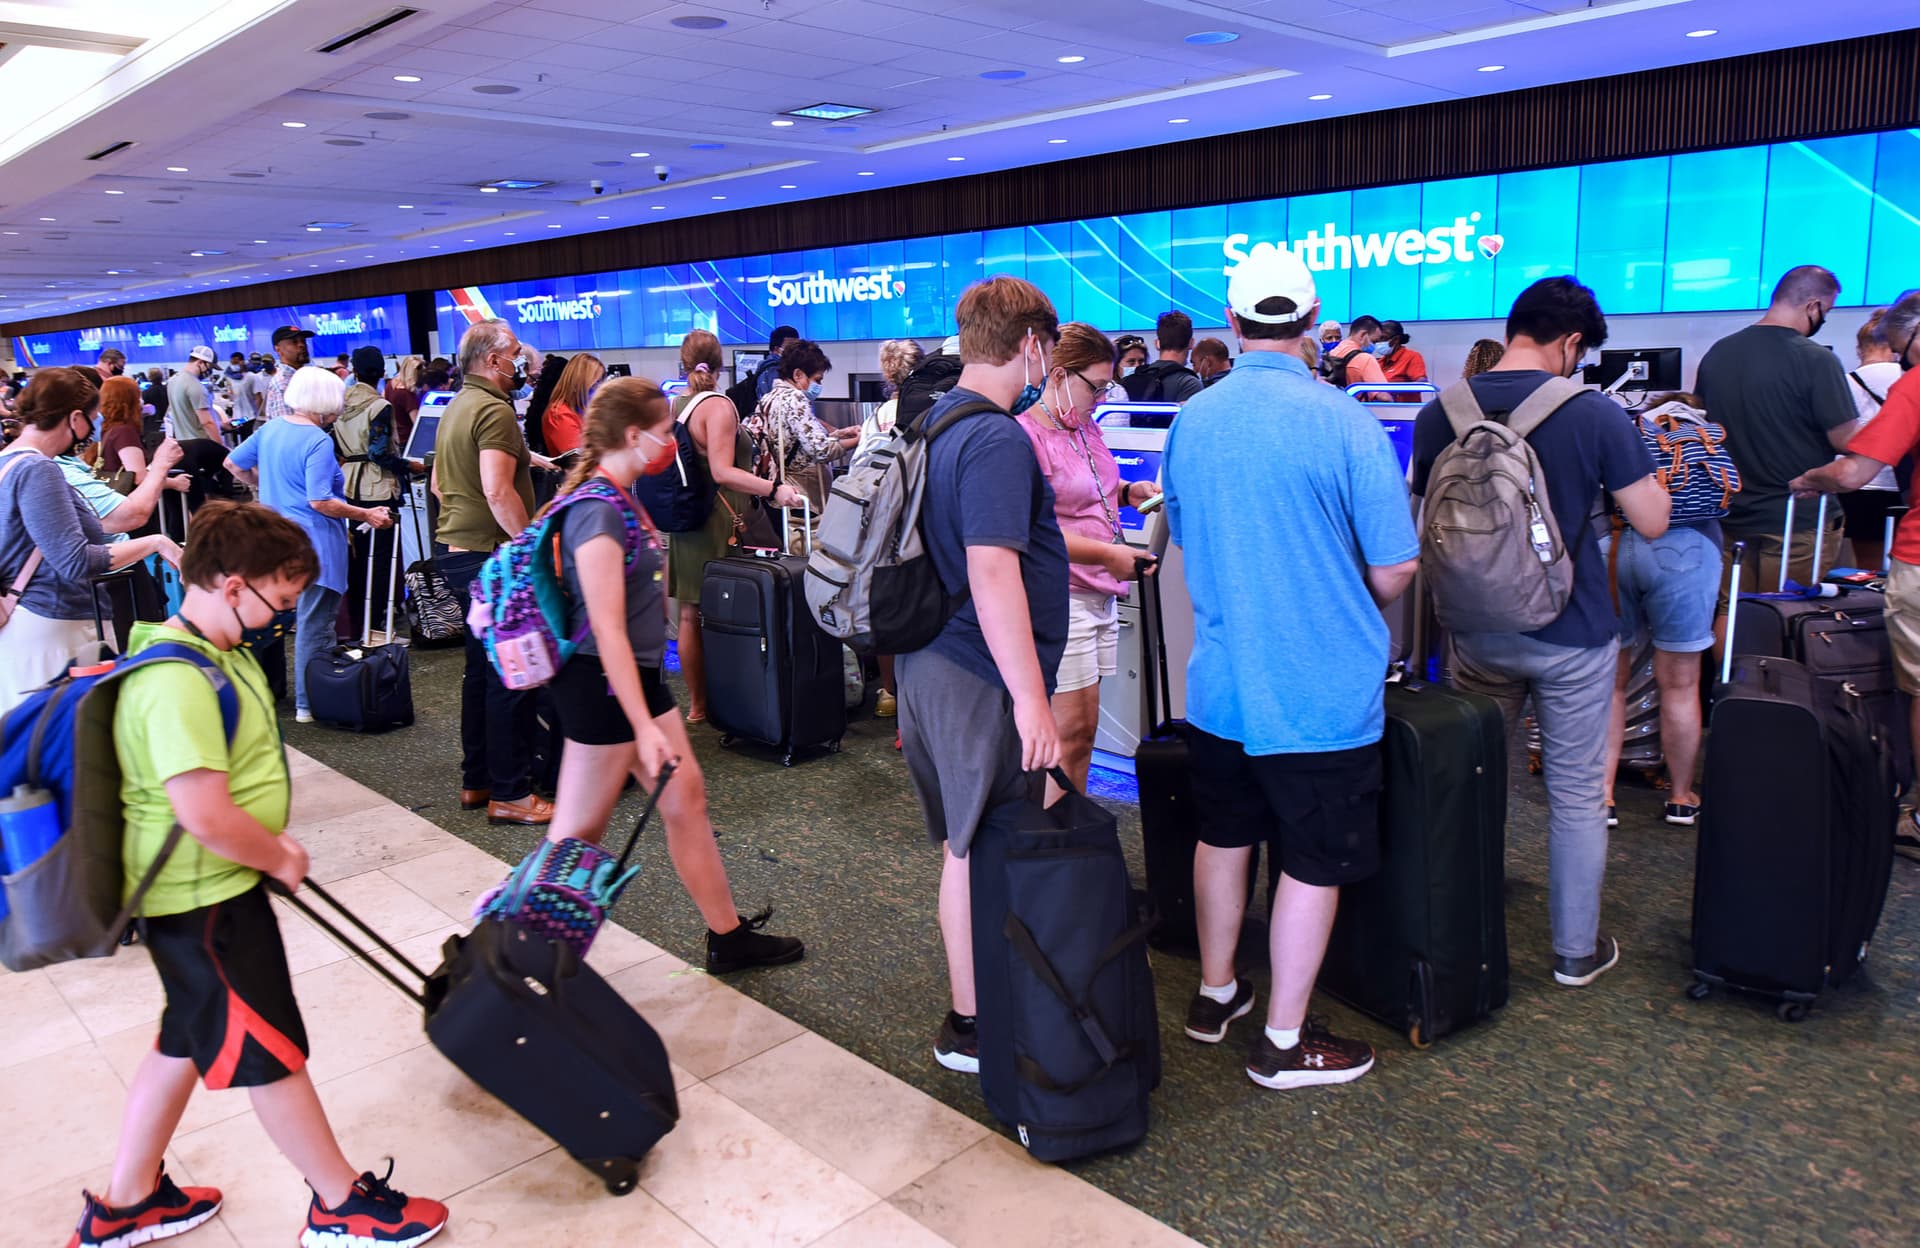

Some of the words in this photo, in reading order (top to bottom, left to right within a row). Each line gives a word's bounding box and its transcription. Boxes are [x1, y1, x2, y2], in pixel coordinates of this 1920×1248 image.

[1223, 216, 1475, 277] Sthwest
[767, 268, 893, 307] Southwest
[517, 295, 594, 323] Southwest
